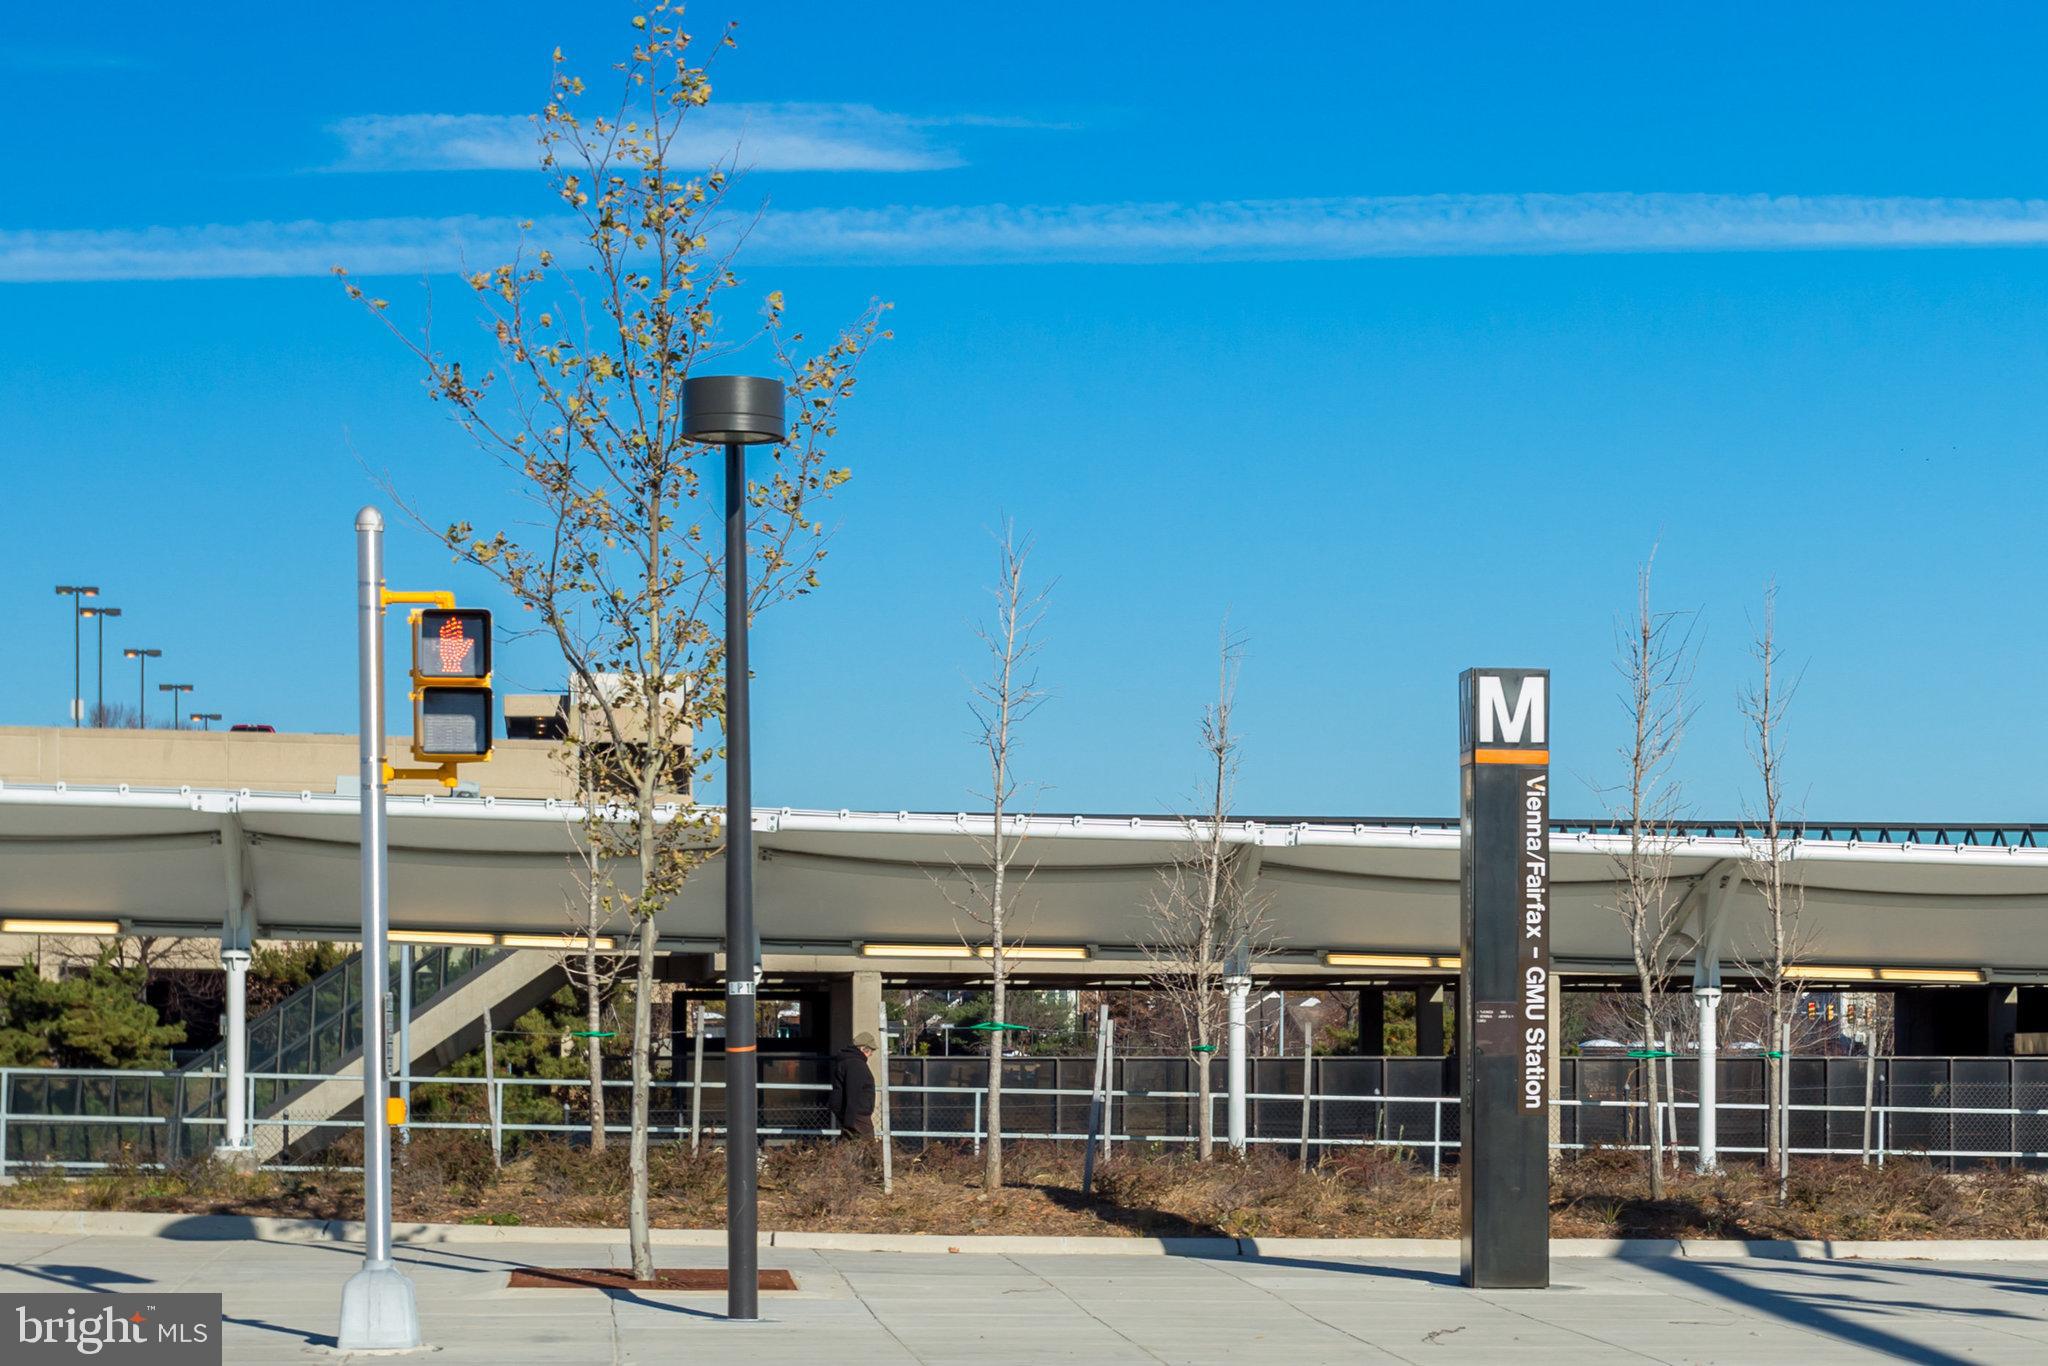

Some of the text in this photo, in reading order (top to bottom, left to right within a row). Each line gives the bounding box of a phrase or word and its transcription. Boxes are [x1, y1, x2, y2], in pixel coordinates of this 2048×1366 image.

[1478, 675, 1546, 744] M
[1525, 774, 1546, 939] Vienna/Fairfax
[1525, 966, 1546, 1021] GMU
[1525, 1027, 1546, 1109] Station
